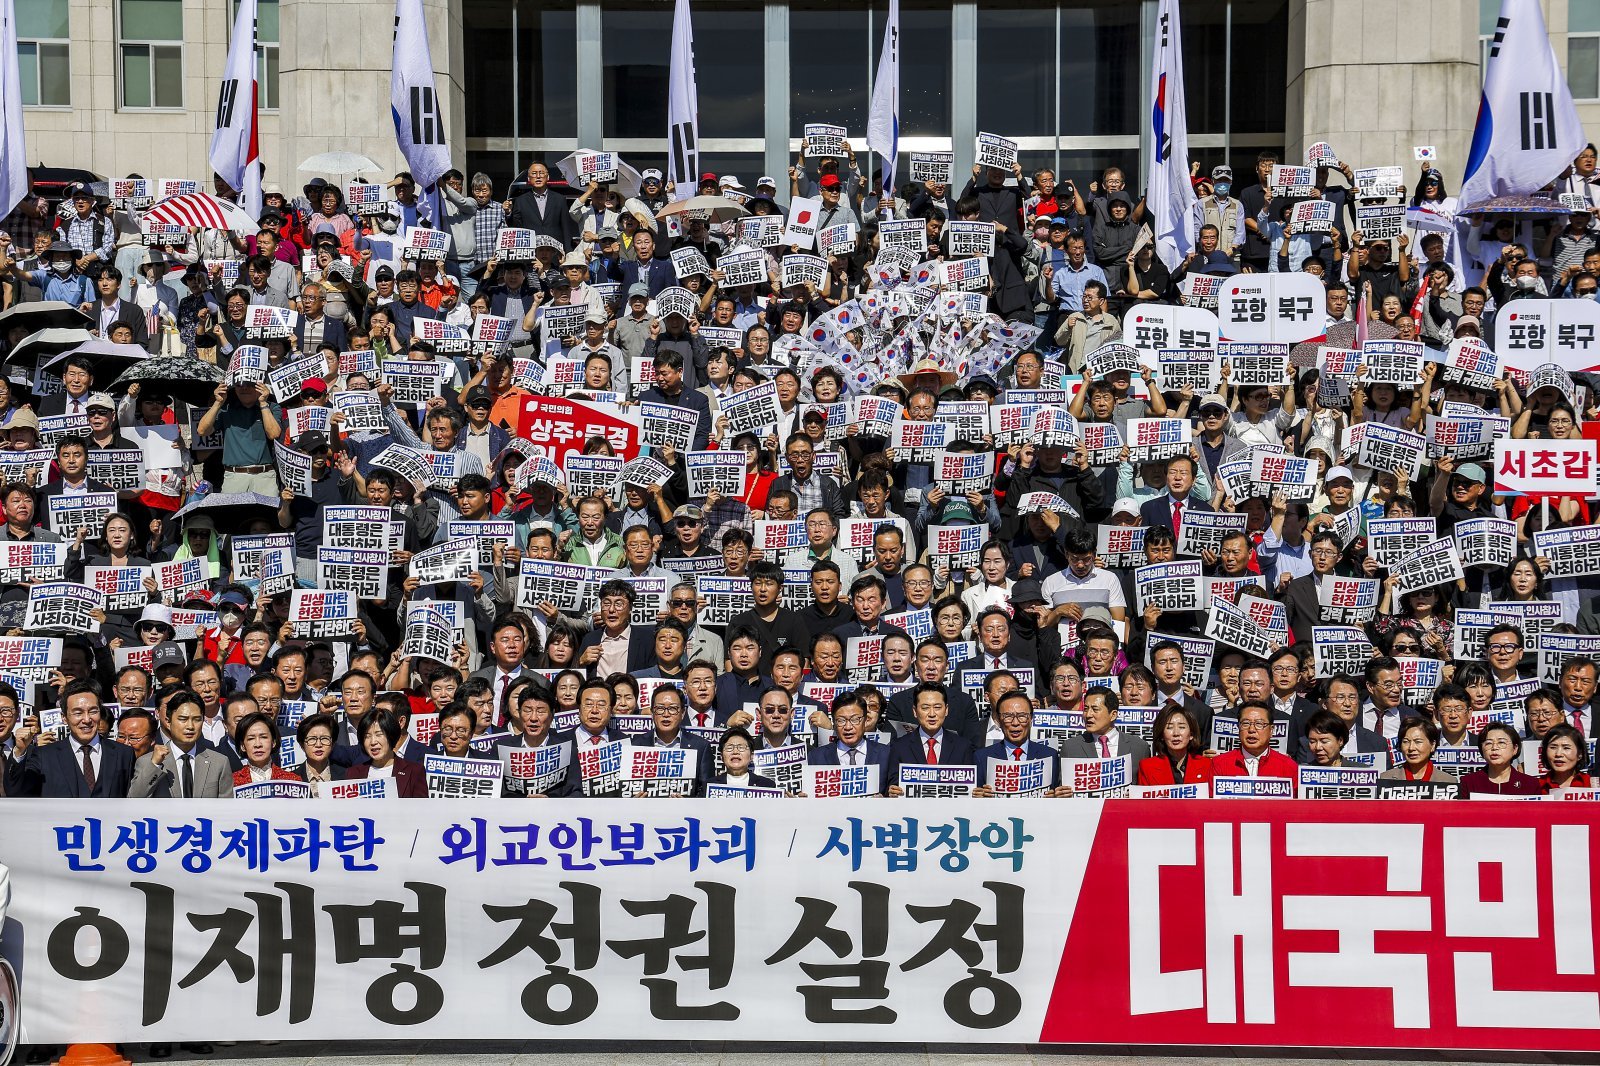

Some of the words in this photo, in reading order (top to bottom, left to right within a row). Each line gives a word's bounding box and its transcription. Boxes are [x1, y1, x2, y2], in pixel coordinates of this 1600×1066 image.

[789, 224, 815, 236] 국민의힘
[1231, 298, 1268, 323] 포항
[1278, 297, 1313, 322] 북구
[1136, 326, 1168, 349] 포항
[1179, 329, 1211, 349] 북구
[1508, 324, 1546, 350] 포항
[1558, 324, 1595, 350] 북구
[1367, 355, 1418, 369] 대통령은
[1460, 345, 1498, 364] 민생파탄
[1162, 363, 1209, 377] 대통령은
[1232, 357, 1284, 370] 대통령은
[387, 375, 435, 389] 대통령은
[1233, 369, 1284, 384] 사죄하라
[1365, 368, 1418, 384] 사죄하라
[540, 404, 573, 415] 국민의힘
[724, 397, 775, 421] 대통령은
[643, 418, 690, 438] 대통령은
[729, 413, 778, 435] 사죄하라
[902, 423, 946, 437] 민생파탄
[1137, 420, 1182, 433] 민생파탄
[1435, 421, 1483, 433] 민생파탄
[901, 435, 945, 447] 헌정파괴
[1137, 431, 1182, 444] 헌정파괴
[1434, 432, 1481, 444] 헌정파괴
[1129, 447, 1149, 462] 강력
[1151, 443, 1190, 461] 규탄한다
[1367, 439, 1418, 463] 대통령은
[943, 454, 986, 467] 민생파탄
[1262, 456, 1308, 472] 민생파탄
[1499, 450, 1592, 480] 서초갑
[569, 470, 616, 484] 대통령은
[690, 466, 739, 481] 대통령은
[942, 465, 985, 479] 헌정파괴
[1260, 468, 1306, 483] 헌정파괴
[326, 508, 390, 521] 정책실패·인사참사
[329, 523, 382, 537] 대통령은
[938, 527, 981, 543] 민생파탄
[8, 543, 56, 556] 민생파탄
[937, 538, 981, 554] 헌정파괴
[1461, 534, 1512, 551] 대통령은
[8, 554, 56, 567] 헌정파괴
[320, 550, 387, 564] 정책실패·인사참사
[1463, 549, 1512, 565] 사죄하라
[96, 567, 142, 581] 민생파탄
[161, 559, 201, 576] 민생파탄
[323, 564, 380, 579] 대통령은
[1, 568, 24, 584] 강력
[95, 580, 141, 594] 헌정파괴
[524, 575, 578, 594] 대통령은
[1140, 579, 1195, 598] 대통령은
[1334, 580, 1375, 594] 민생파탄
[300, 591, 348, 607] 민생파탄
[1331, 592, 1373, 607] 헌정파괴
[33, 601, 94, 616] 대통령은
[298, 604, 348, 620] 헌정파괴
[1320, 607, 1342, 623] 강력
[30, 614, 93, 630] 사죄하라
[172, 611, 217, 624] 민생파탄
[1212, 627, 1269, 653] 사죄하라
[1320, 643, 1373, 660] 대통령은
[510, 746, 562, 765] 민생파탄
[634, 750, 686, 765] 민생파탄
[427, 758, 500, 777] 정책실패·인사참사
[510, 760, 560, 780] 헌정파괴
[631, 763, 683, 779] 헌정파괴
[815, 766, 869, 784] 민생파탄
[902, 767, 975, 783] 정책실패·인사참사
[995, 760, 1044, 779] 민생파탄
[1075, 758, 1126, 777] 민생파탄
[429, 775, 493, 794] 대통령은
[994, 773, 1043, 793] 헌정파괴
[1074, 772, 1126, 792] 헌정파괴
[1301, 770, 1377, 786] 정책실패·인사참사
[332, 780, 385, 798] 민생파탄
[622, 780, 644, 797] 강력
[647, 780, 693, 797] 규탄한다
[814, 780, 868, 798] 헌정파괴
[1217, 780, 1290, 795] 정책실패·인사참사
[53, 817, 385, 873] 민생경제파탄
[439, 817, 757, 873] 외교안보파괴
[816, 817, 1034, 873] 사법장악
[1128, 822, 1600, 1030] 대국민
[47, 881, 447, 1027] 이재명
[477, 880, 741, 1026] 정권
[765, 880, 1026, 1029] 실정
